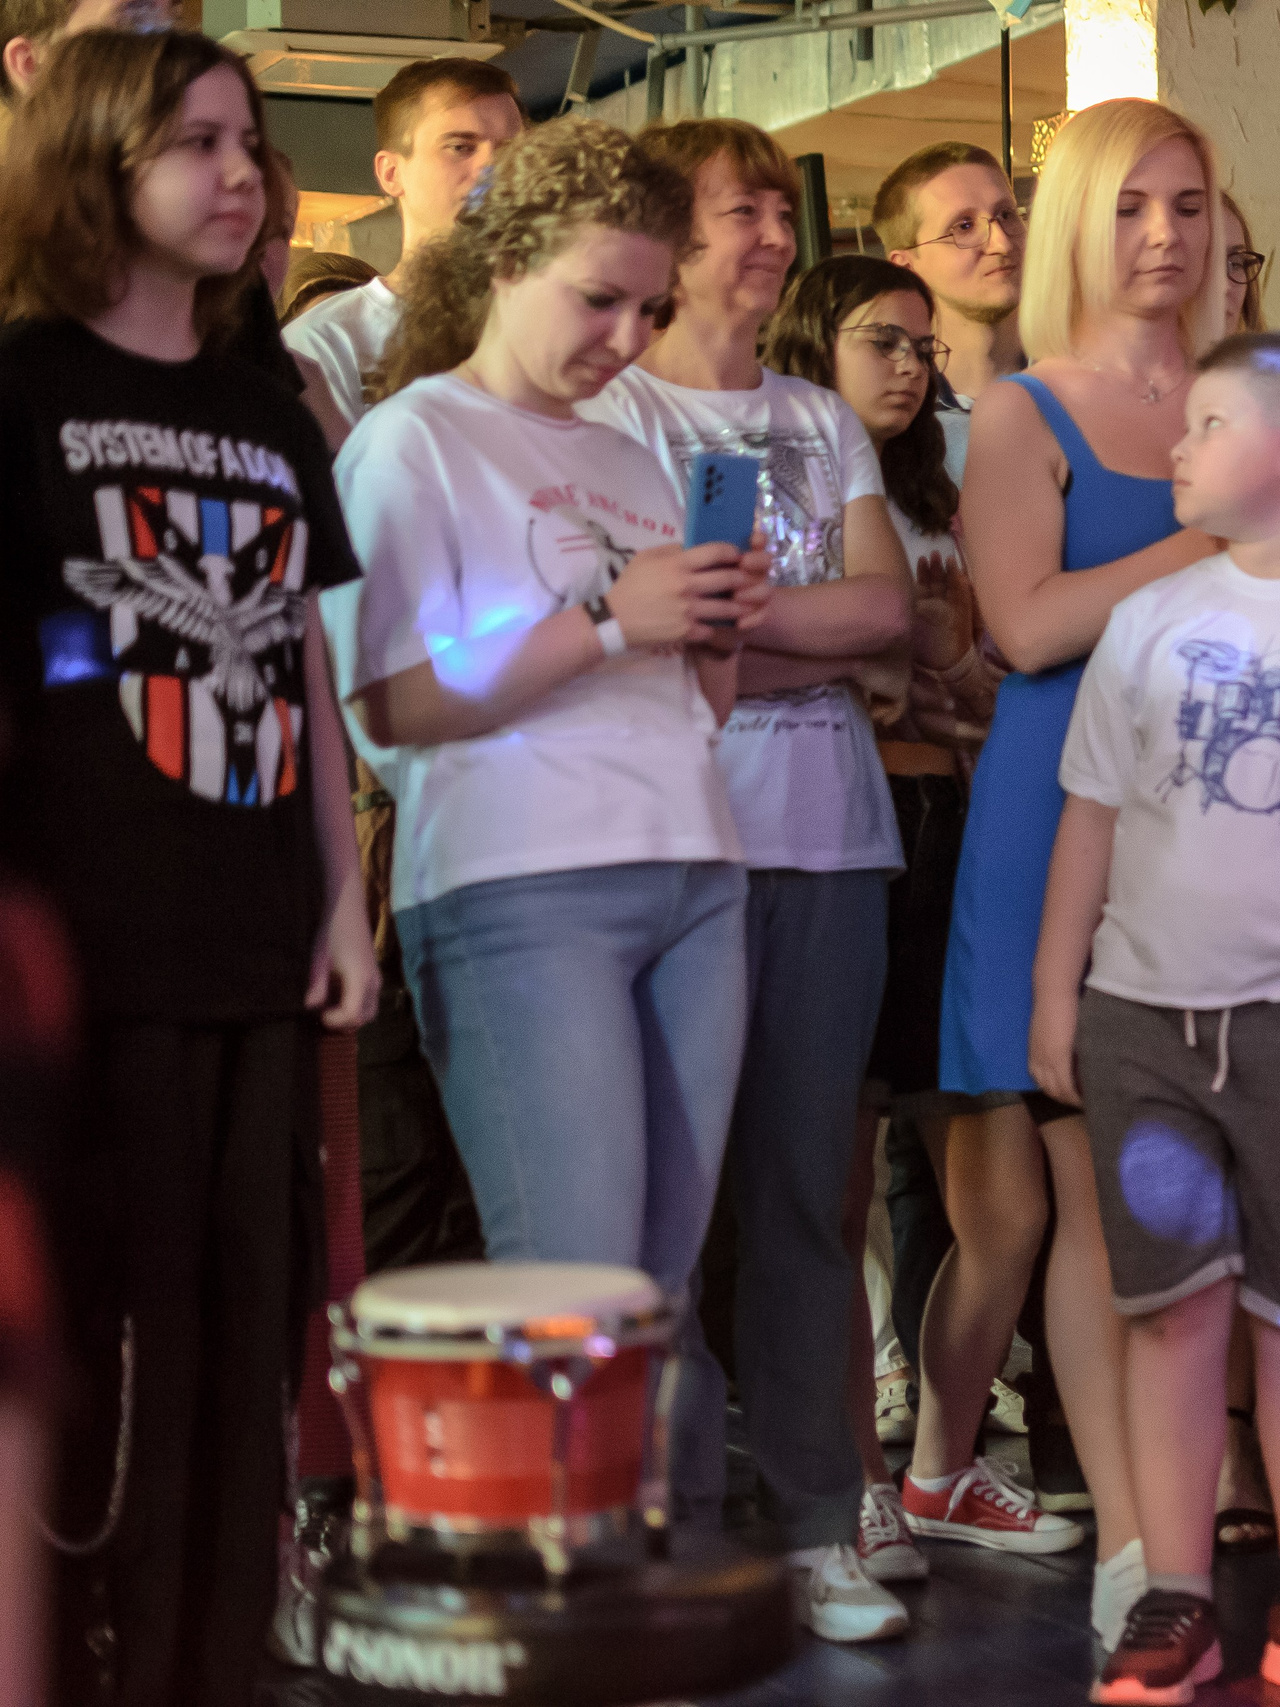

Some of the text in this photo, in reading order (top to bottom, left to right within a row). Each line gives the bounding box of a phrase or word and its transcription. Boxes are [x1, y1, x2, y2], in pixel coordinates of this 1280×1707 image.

[60, 420, 185, 473] SYSTEM
[179, 428, 218, 478] OF
[218, 436, 247, 482] A
